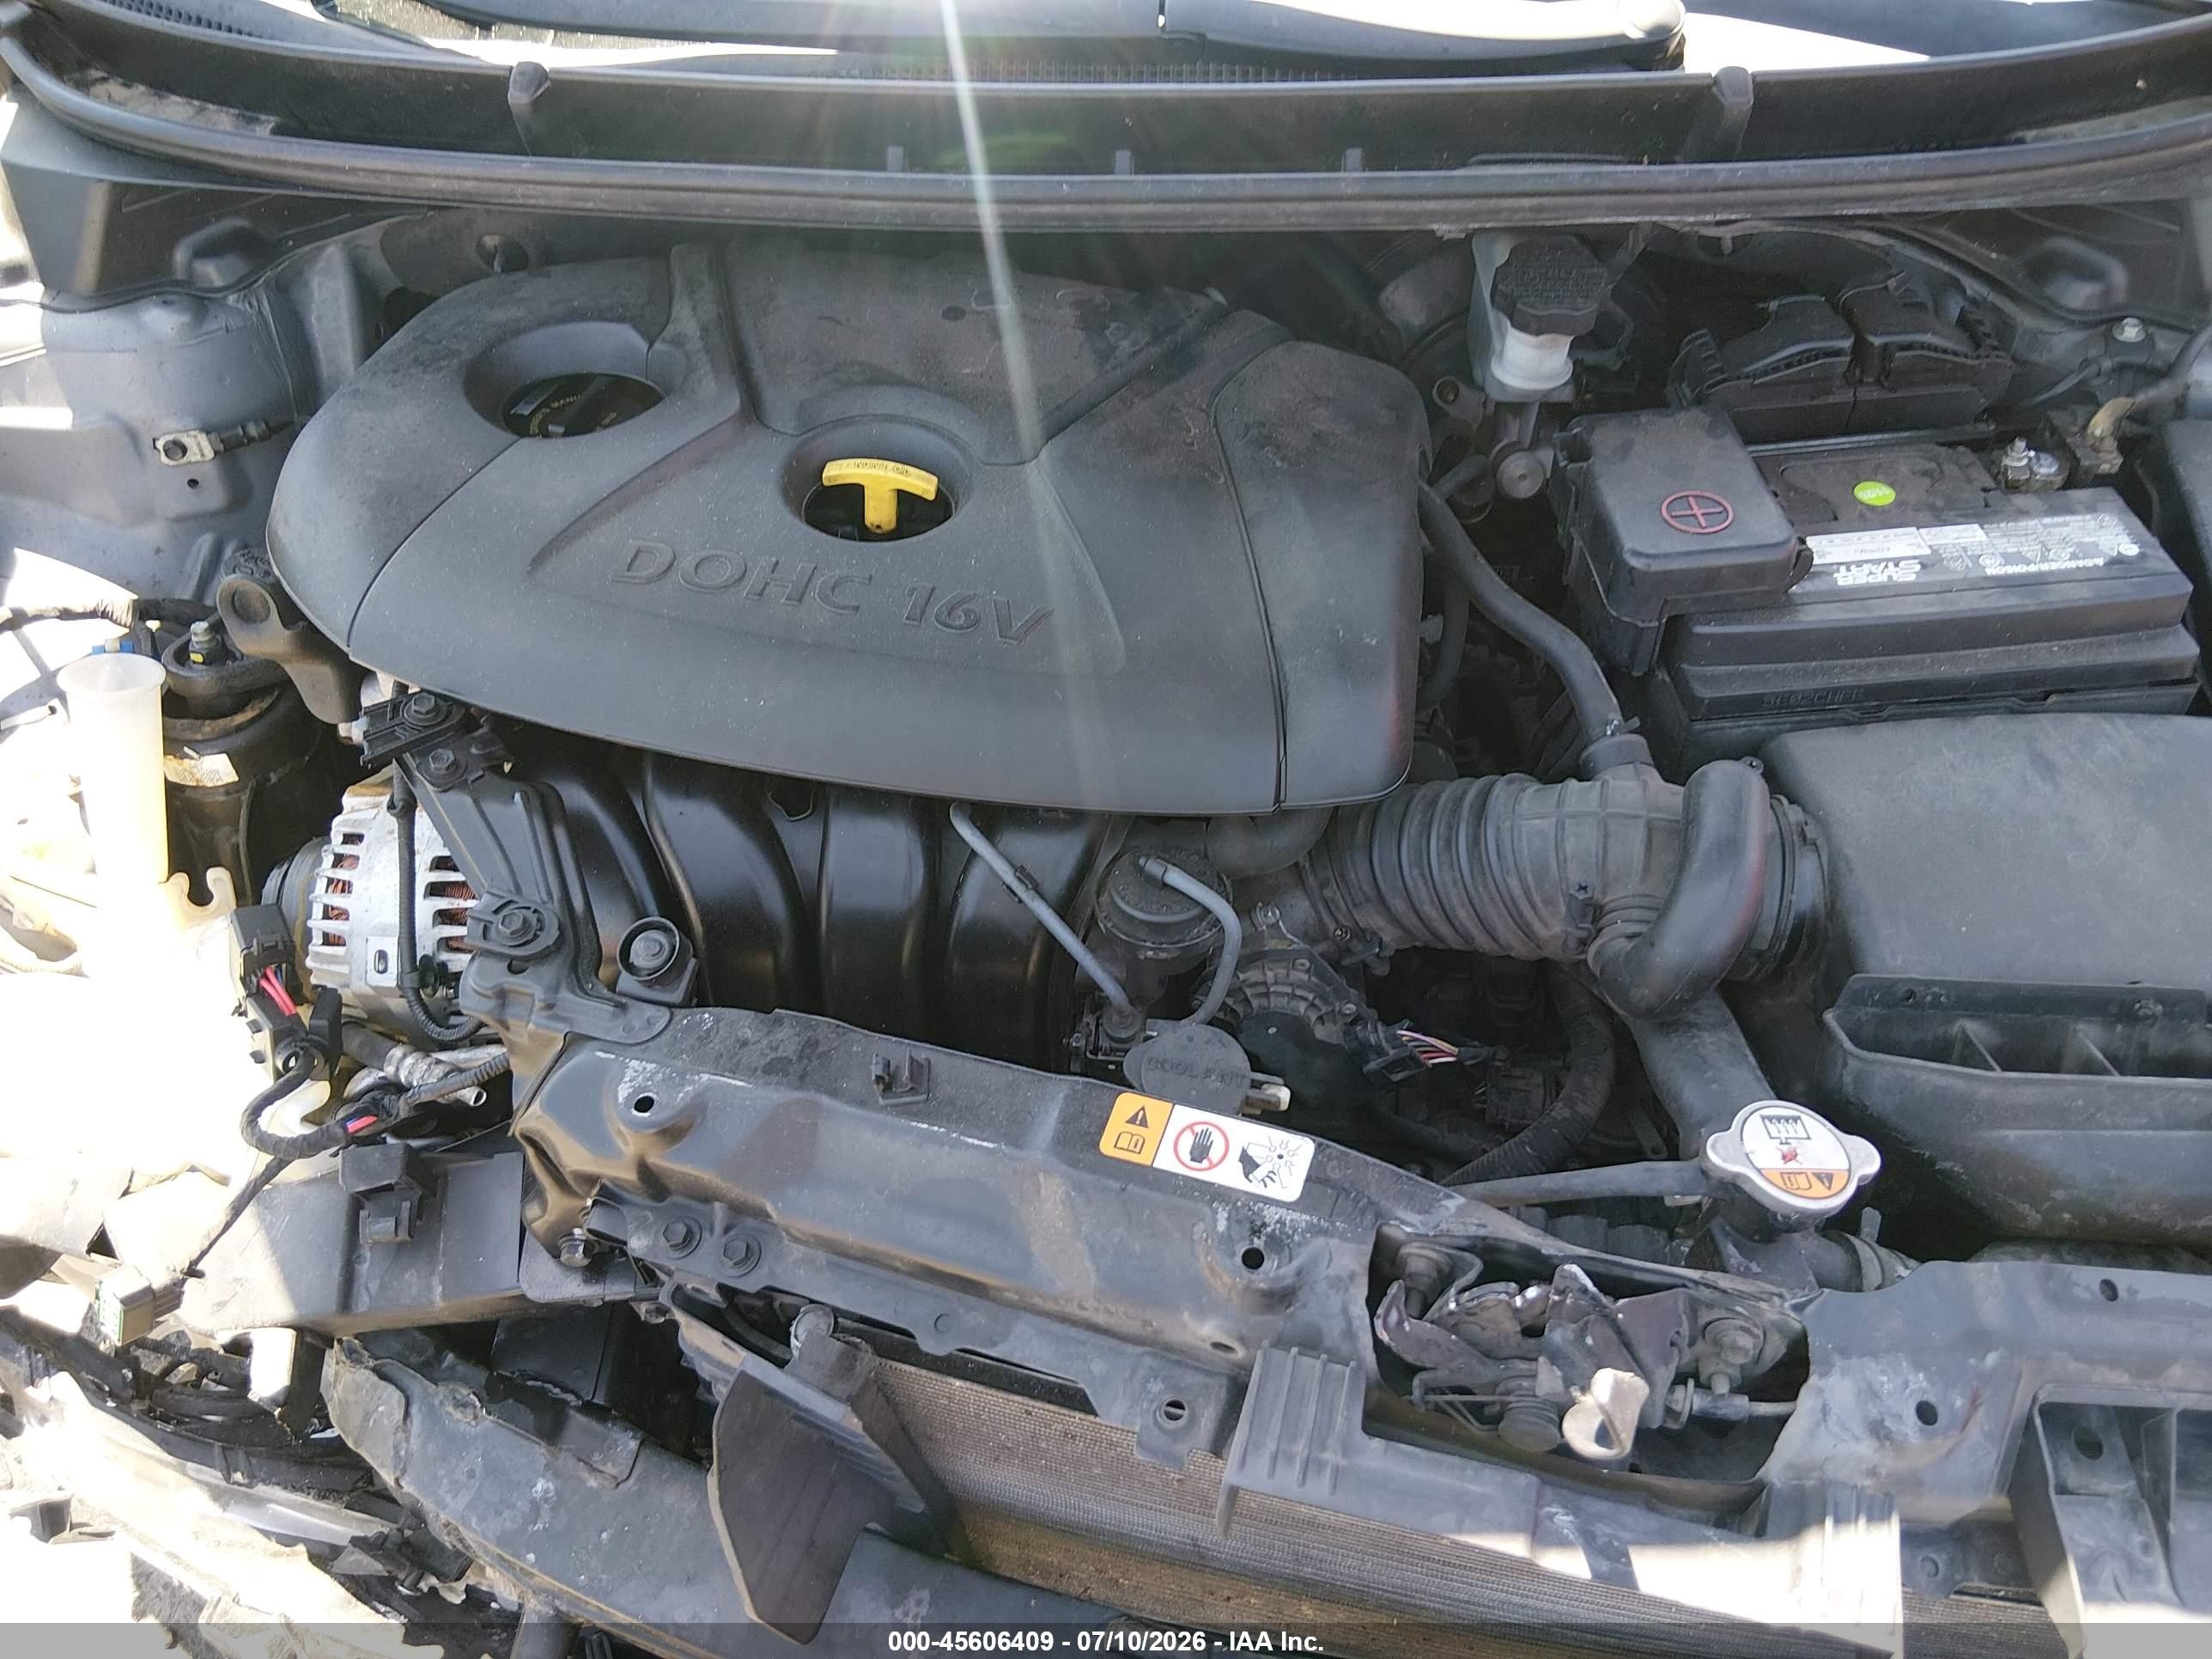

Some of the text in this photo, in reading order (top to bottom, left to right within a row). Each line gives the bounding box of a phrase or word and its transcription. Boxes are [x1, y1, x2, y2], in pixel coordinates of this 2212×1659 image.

[1832, 559, 1922, 577] START
[1836, 571, 1917, 586] SUPER
[609, 538, 1054, 644] DOHC 16V
[1146, 1056, 1247, 1087] COOLANT
